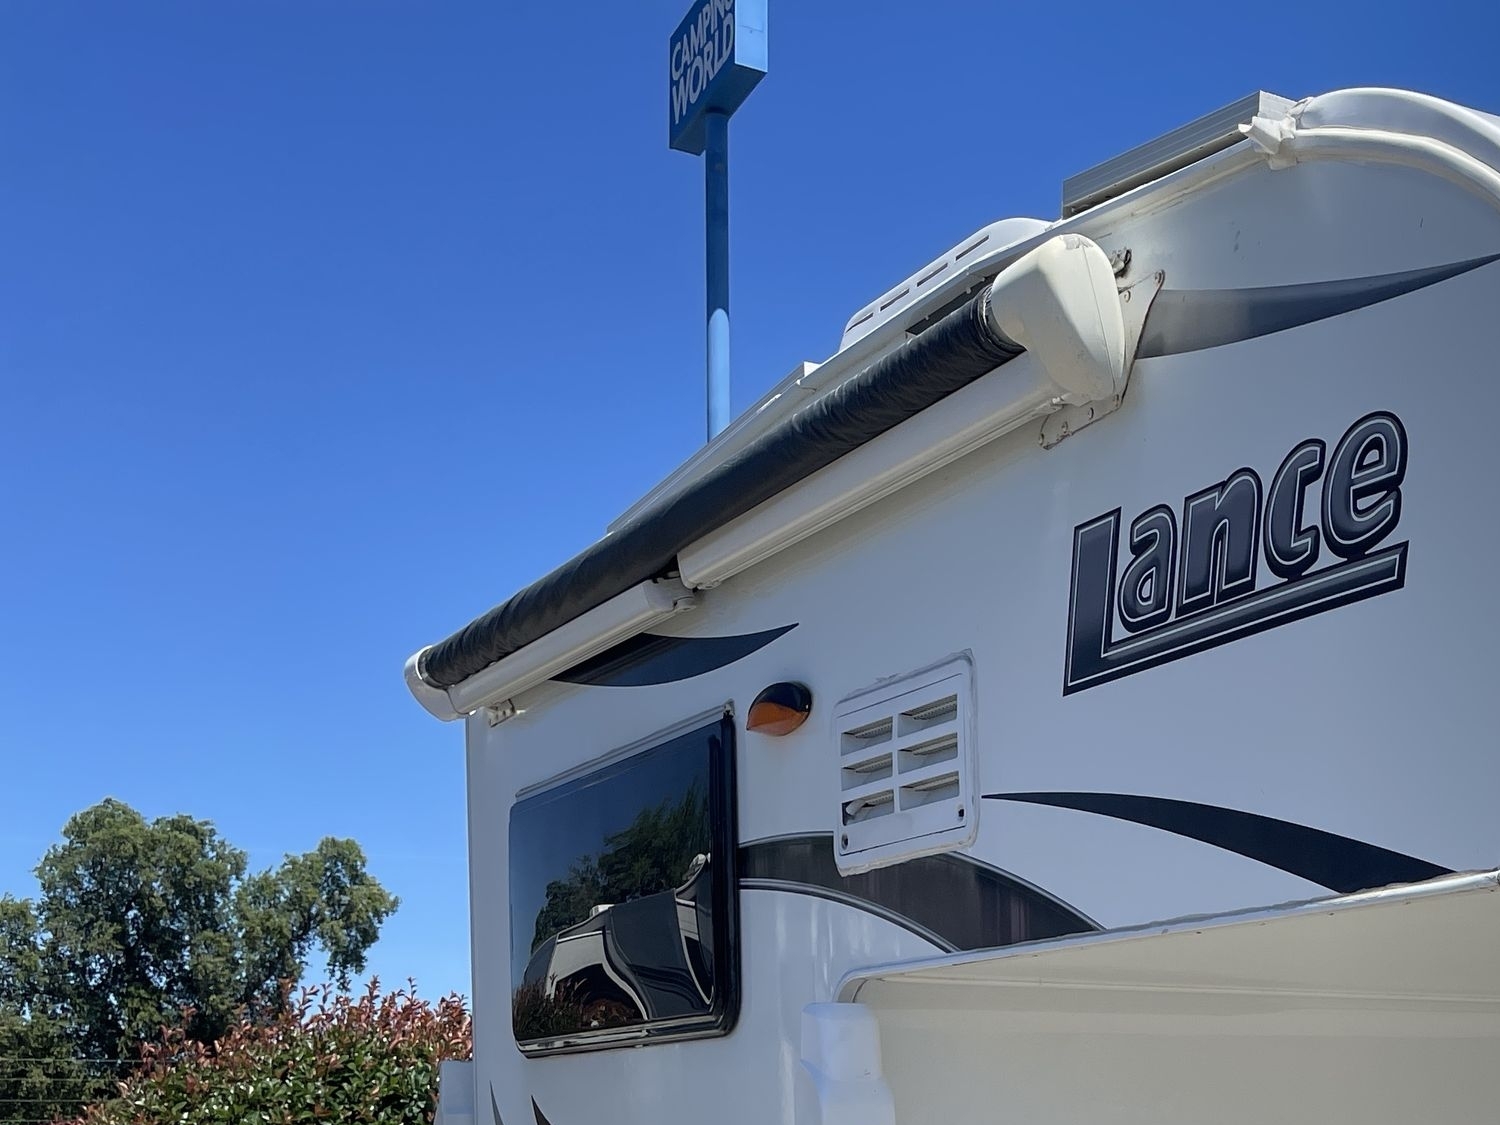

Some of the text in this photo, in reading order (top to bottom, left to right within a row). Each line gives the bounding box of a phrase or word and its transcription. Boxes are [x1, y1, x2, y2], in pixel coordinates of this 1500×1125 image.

[671, 0, 734, 81] CAMPIN
[672, 12, 734, 125] WORLD
[1063, 410, 1410, 697] Lance
